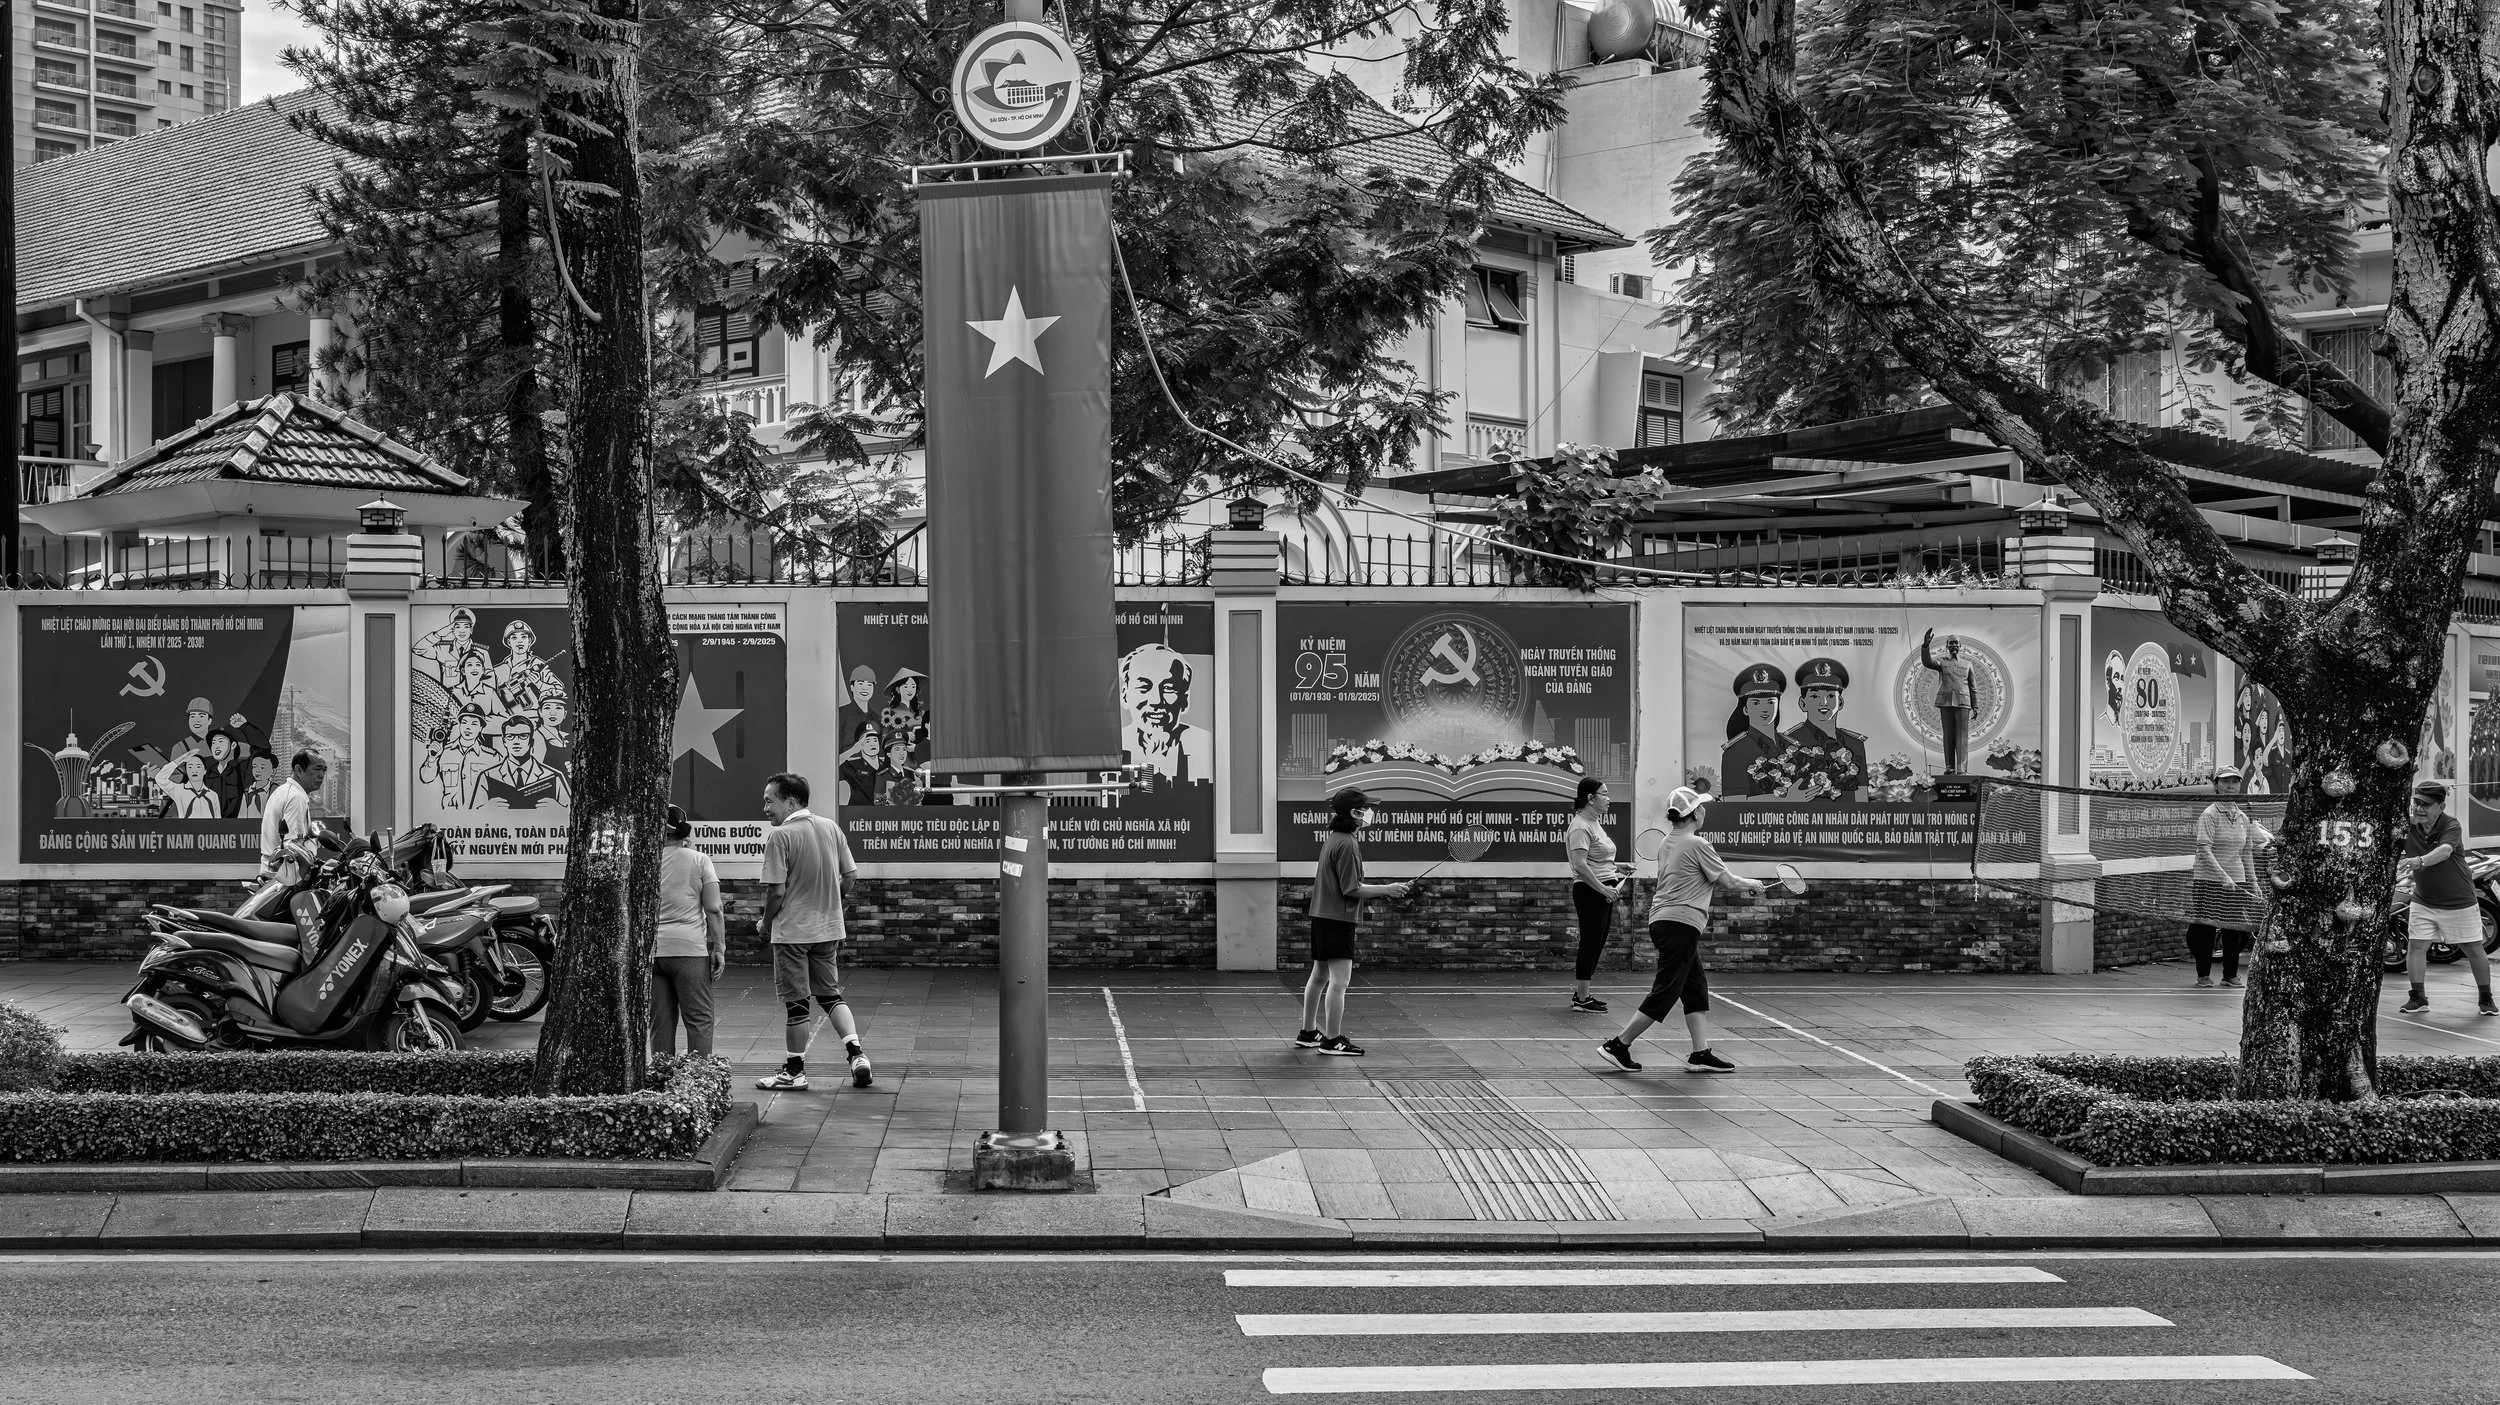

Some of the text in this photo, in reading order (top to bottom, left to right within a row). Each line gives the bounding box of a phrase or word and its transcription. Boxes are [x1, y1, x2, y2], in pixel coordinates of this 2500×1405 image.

[864, 612, 1183, 627] NHIỆT LIỆT HỒ CHÍ MINH
[702, 638, 735, 646] 2/9/1945
[1300, 635, 1346, 653] KỶ NIỆM
[1521, 645, 1616, 660] NGÀY TRUYỀN THỐNG
[1295, 652, 1380, 690] 95 NĂM
[1524, 663, 1612, 677] NGÀNH TUYÊN GIÁO
[1545, 678, 1592, 694] CỦA ĐẢNG
[2136, 678, 2158, 708] 80
[1289, 692, 1380, 701] (01/8/1930 01/8/2025)
[849, 818, 872, 831] KIÊN
[875, 820, 898, 834] ĐỊNH
[901, 820, 923, 834] MỤC
[926, 818, 946, 831] TIÊU
[949, 818, 969, 834] ĐỘC
[972, 818, 990, 834] LẬP
[1060, 817, 1081, 831] LIỀN
[1084, 818, 1100, 831] VỚI
[1102, 817, 1122, 831] CHỦ
[1125, 818, 1155, 831] NGHĨA
[1158, 818, 1171, 831] XÃ
[1174, 818, 1190, 834] HỘI
[1293, 810, 1328, 824] NGÀNH
[1391, 810, 1424, 824] THÀNH
[1427, 809, 1447, 824] PHỐ
[1450, 809, 1463, 824] HỒ
[1466, 810, 1483, 824] CHÍ
[1486, 813, 1512, 824] MINH
[1522, 810, 1543, 824] TIẾP
[1546, 813, 1564, 827] TỤC
[1740, 812, 1755, 827] LỰC
[1758, 812, 1784, 827] LƯỢNG
[1786, 811, 1809, 825] CÔNG
[1811, 813, 1823, 825] AN
[1826, 811, 1848, 825] NHÂN
[1851, 810, 1868, 825] DÂN
[1870, 811, 1891, 825] PHÁT
[1894, 813, 1909, 825] HUY
[1912, 813, 1924, 825] VAI
[1927, 811, 1942, 825] TRÒ
[1945, 811, 1968, 825] NÒNG
[440, 824, 762, 839] TOÀN ĐẢNG, TOÀN VỮNG BƯỚC
[1368, 828, 1383, 842] SỨ
[1416, 827, 1447, 843] ĐẢNG,
[1450, 829, 1470, 842] NHÀ
[1474, 829, 1500, 842] NƯỚC
[1503, 829, 1516, 842] VÀ
[1519, 829, 1547, 843] NHÂN
[1699, 832, 1725, 844] TRONG
[1728, 831, 1740, 846] SỰ
[1742, 829, 1771, 846] NGHIỆP
[1774, 828, 1790, 844] BẢO
[1792, 830, 1802, 846] VỆ
[1805, 832, 1816, 844] AN
[1819, 832, 1839, 844] NINH
[1842, 828, 1864, 845] QUỐC
[1866, 832, 1882, 845] GIA,
[1885, 828, 1901, 844] BẢO
[1903, 828, 1922, 844] ĐẢM
[1924, 830, 1944, 846] TRẬT
[1946, 831, 1959, 846] TỰ,
[1961, 832, 1973, 844] AN
[2013, 830, 2026, 846] HỘI
[2318, 820, 2374, 848] 153
[40, 829, 262, 852] ĐẢNG CỘNG SẢN VIỆT NAM QUANG VIN
[450, 840, 766, 856] KỶ NGUYÊN MỚI THỊNH VƯỢN
[862, 836, 887, 849] TRÊN
[890, 835, 910, 849] NỀN
[913, 835, 939, 849] TẢNG
[941, 835, 960, 849] CHỦ
[963, 836, 994, 849] NGHĨA
[1062, 838, 1076, 850] TƯ
[1077, 835, 1109, 850] TƯỞNG
[1111, 835, 1125, 850] HỒ
[1127, 836, 1144, 850] CHÍ
[1147, 839, 1176, 849] MINH!
[332, 938, 368, 978] YONEX
